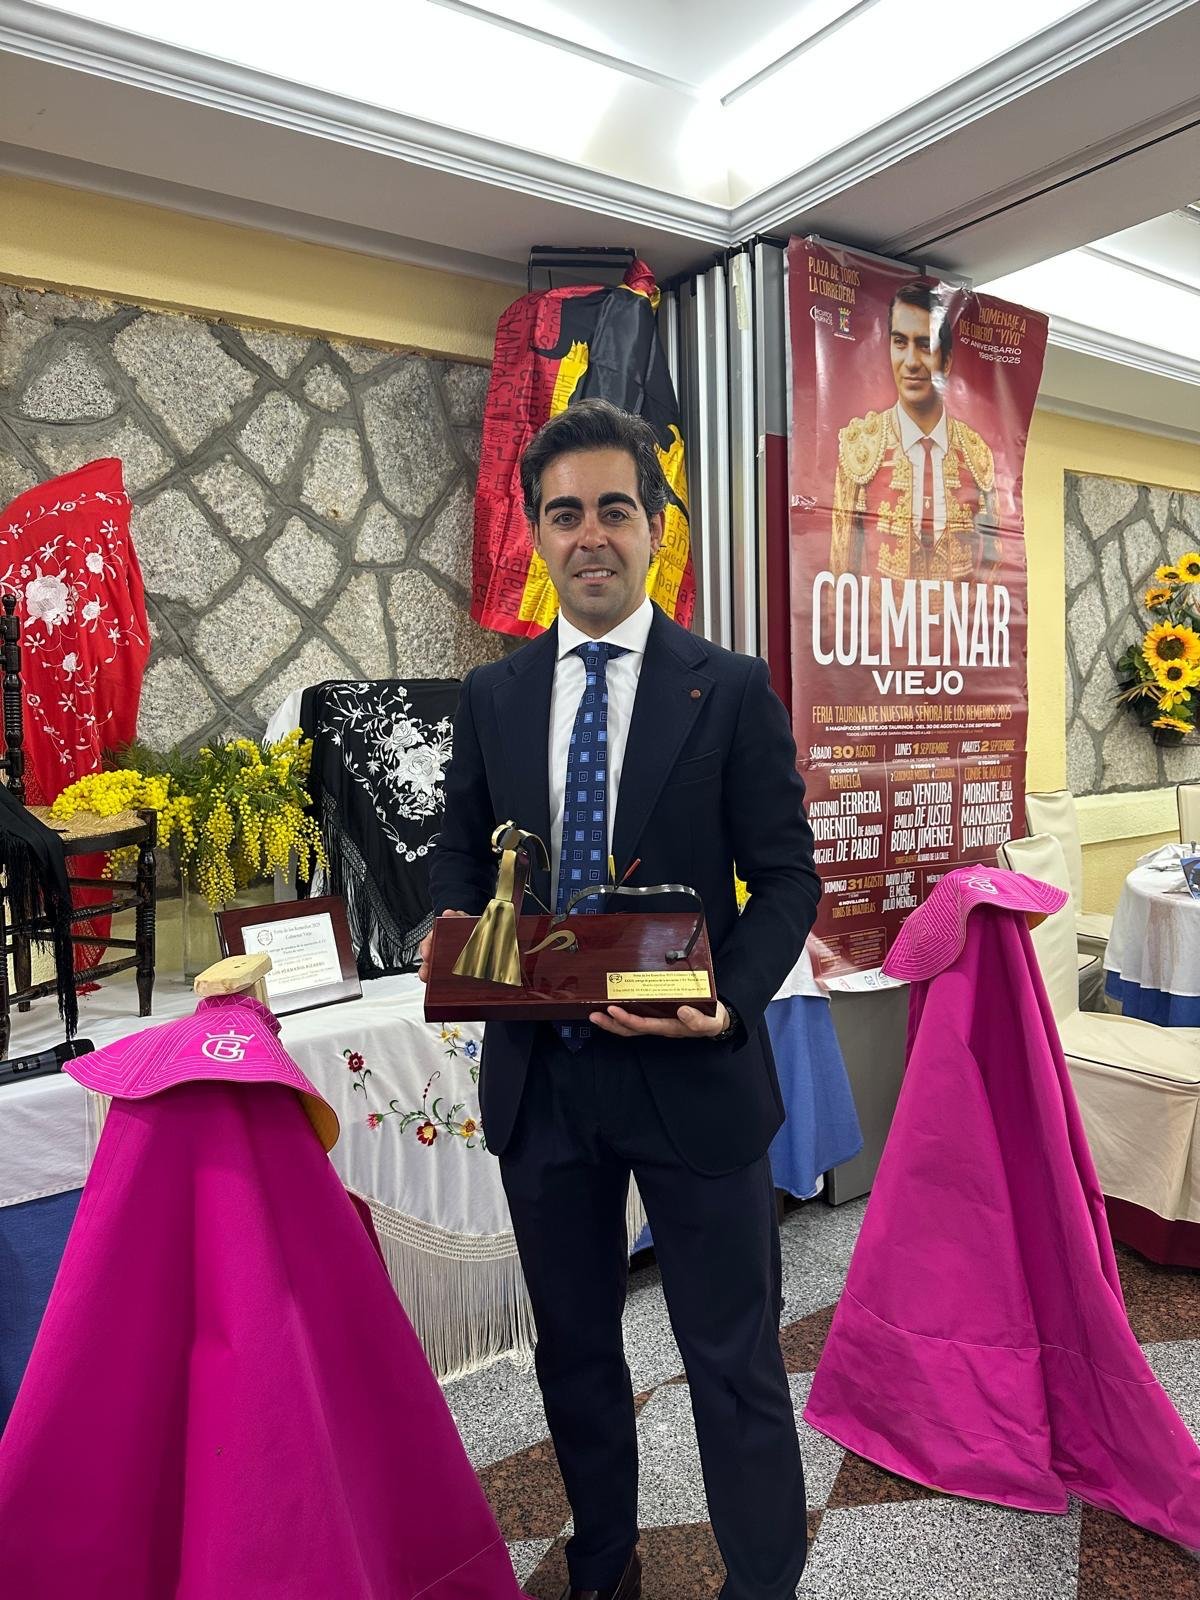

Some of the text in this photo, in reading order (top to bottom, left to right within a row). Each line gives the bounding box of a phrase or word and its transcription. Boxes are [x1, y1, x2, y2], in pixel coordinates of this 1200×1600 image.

[808, 256, 861, 287] PLAZA DE TOROS
[809, 276, 856, 305] LA CORREDERA
[979, 307, 1027, 334] HOMENAJE A
[970, 341, 1022, 356] ANIVERSARIO
[978, 351, 1021, 364] 1985-2025
[812, 570, 1011, 668] COLMENAR
[872, 670, 964, 695] VIEJO
[812, 702, 1012, 724] FERIA TAURINA DE NUESTRA SEÑORA DE LOS REMEDIOS 2025
[810, 744, 876, 761] SÁBADO 30 AGOSTO
[895, 742, 949, 755] LUNES 1 SEPTIEMBRE
[961, 739, 1015, 753] MARTES 2 SEPTIEMBRE
[809, 790, 882, 817] ANTONIO FERRERA
[894, 782, 952, 807] DIEGO VENTURA
[962, 782, 1000, 805] MORANTE
[894, 804, 952, 830] EMILIO DE JUSTO
[961, 803, 1013, 827] MANZANARES
[858, 826, 866, 836] DE
[891, 829, 916, 855] BORJA
[961, 823, 1011, 852] JUAN ORTEGA
[836, 840, 850, 862] DE
[850, 837, 880, 860] PABLO
[824, 874, 884, 893] DOMINGO 31 AGOSTO
[886, 873, 901, 886] DAVID
[890, 886, 895, 897] EL
[881, 898, 896, 914] JULIO
